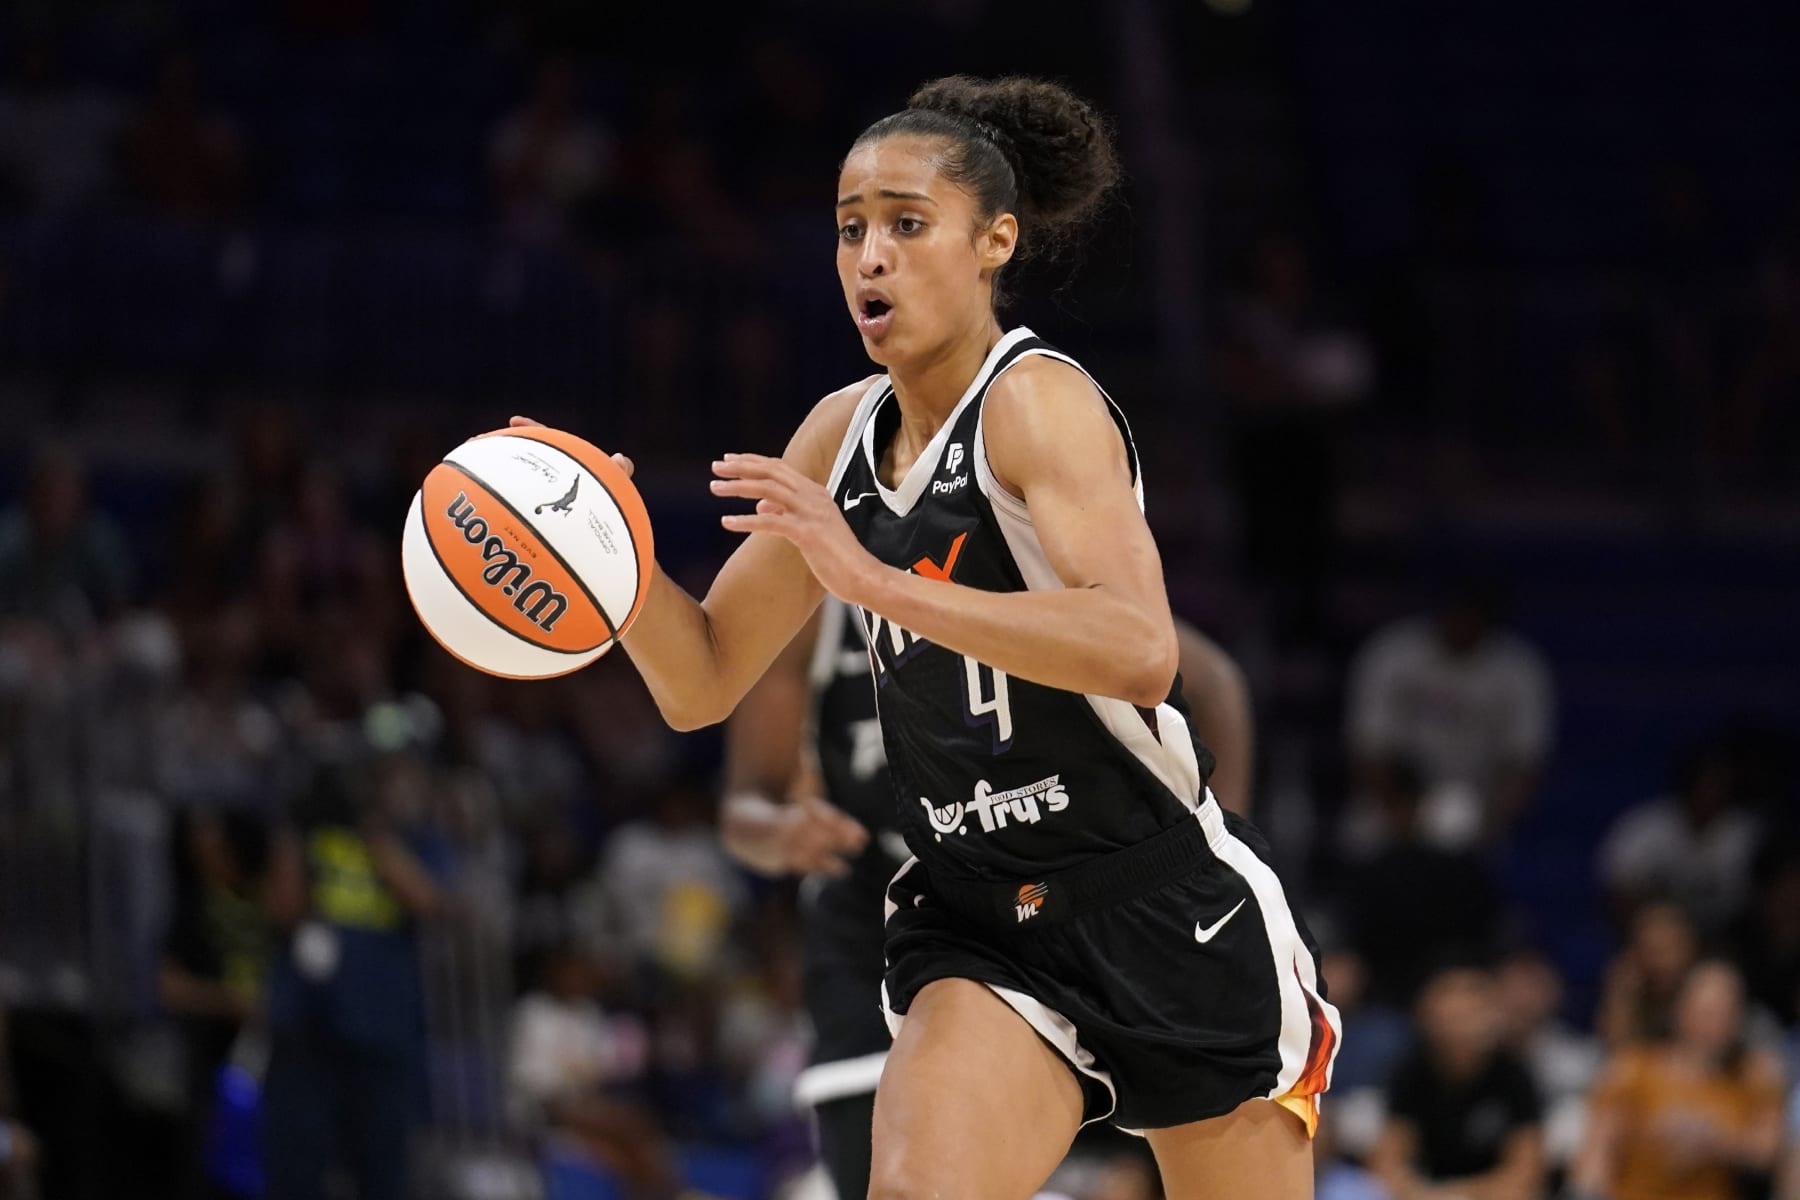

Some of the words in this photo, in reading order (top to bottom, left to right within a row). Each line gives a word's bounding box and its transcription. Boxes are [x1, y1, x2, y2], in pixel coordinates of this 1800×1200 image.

[932, 472, 968, 495] PayPal
[504, 526, 519, 543] NXT
[446, 491, 568, 633] Wilson
[521, 543, 537, 559] EVO
[961, 654, 1013, 744] 4
[990, 792, 1013, 804] FOOD
[1016, 778, 1057, 799] STORES
